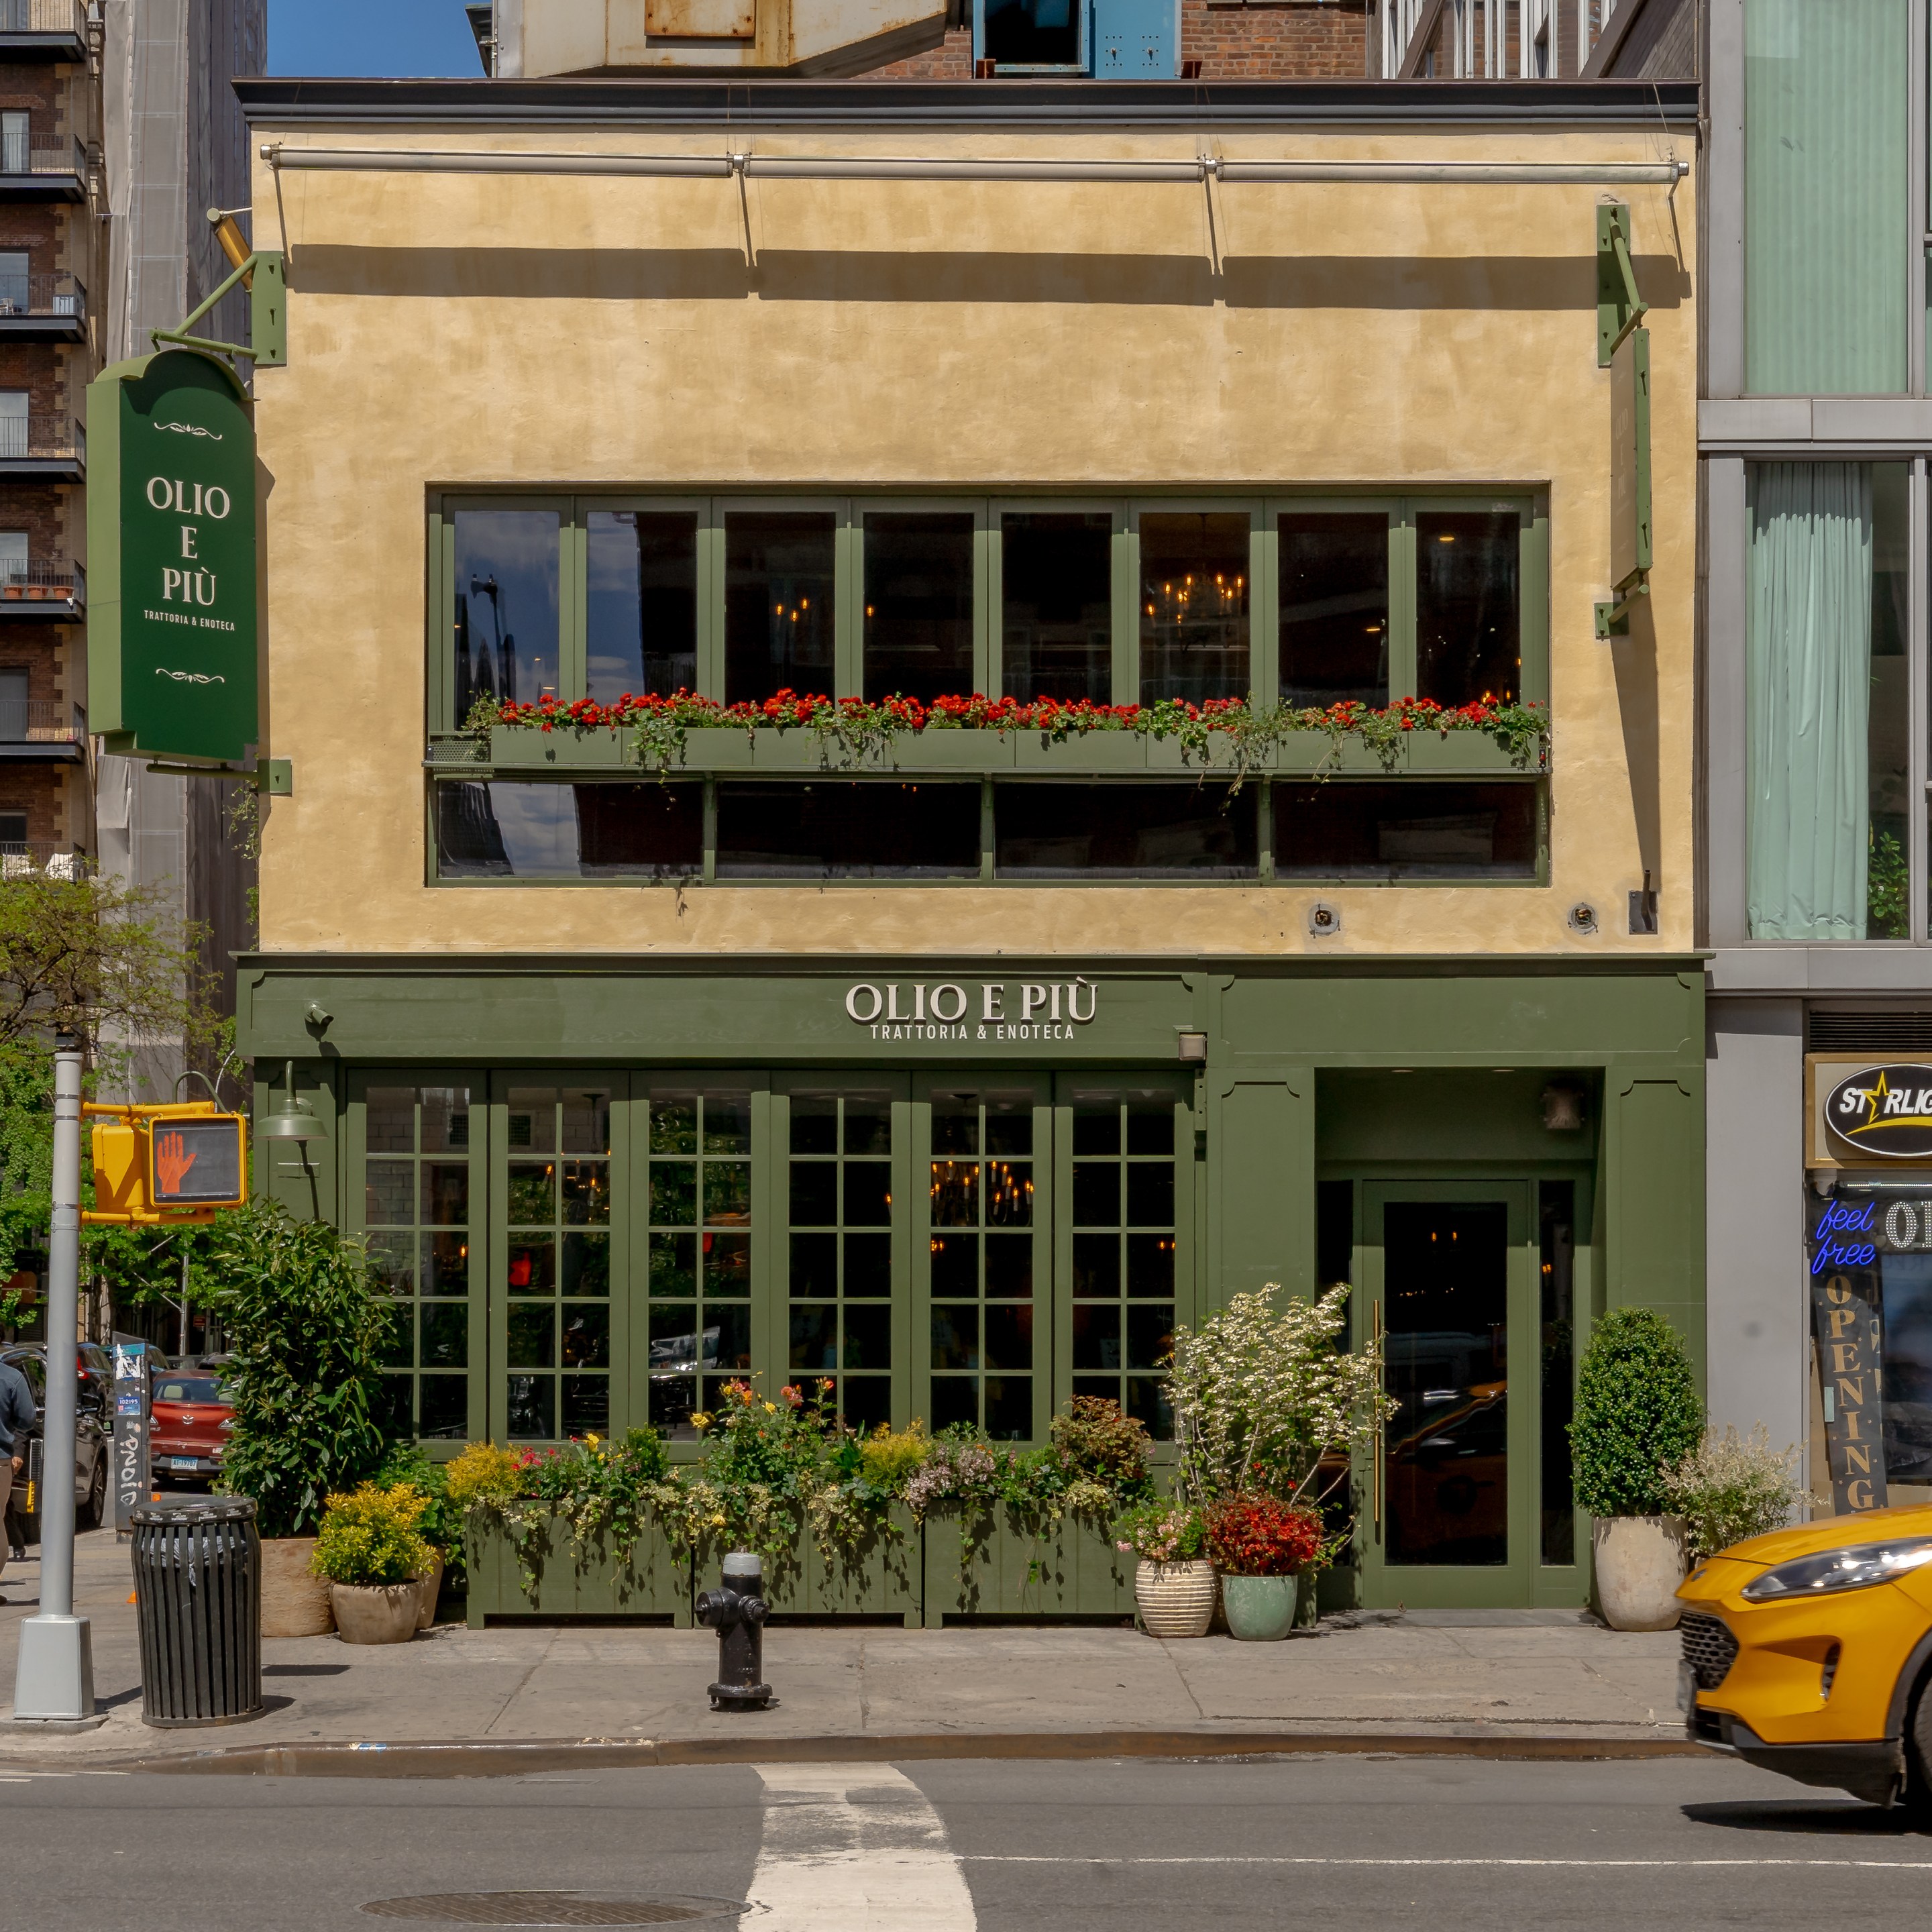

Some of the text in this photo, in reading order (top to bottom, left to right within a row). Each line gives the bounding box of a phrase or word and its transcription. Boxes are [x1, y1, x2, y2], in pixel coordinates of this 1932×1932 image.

[146, 476, 230, 519] OLIO
[180, 525, 198, 559] E
[162, 566, 217, 606] PIÙ
[144, 609, 235, 631] TRATTORIA & ENOTECA
[845, 975, 1099, 1023] OLIO E PIÙ
[870, 1024, 1075, 1040] TRATTORIA & ENOTECA
[1815, 1199, 1876, 1240] feel
[1811, 1234, 1877, 1275] free
[1826, 1275, 1875, 1509] OPENING
